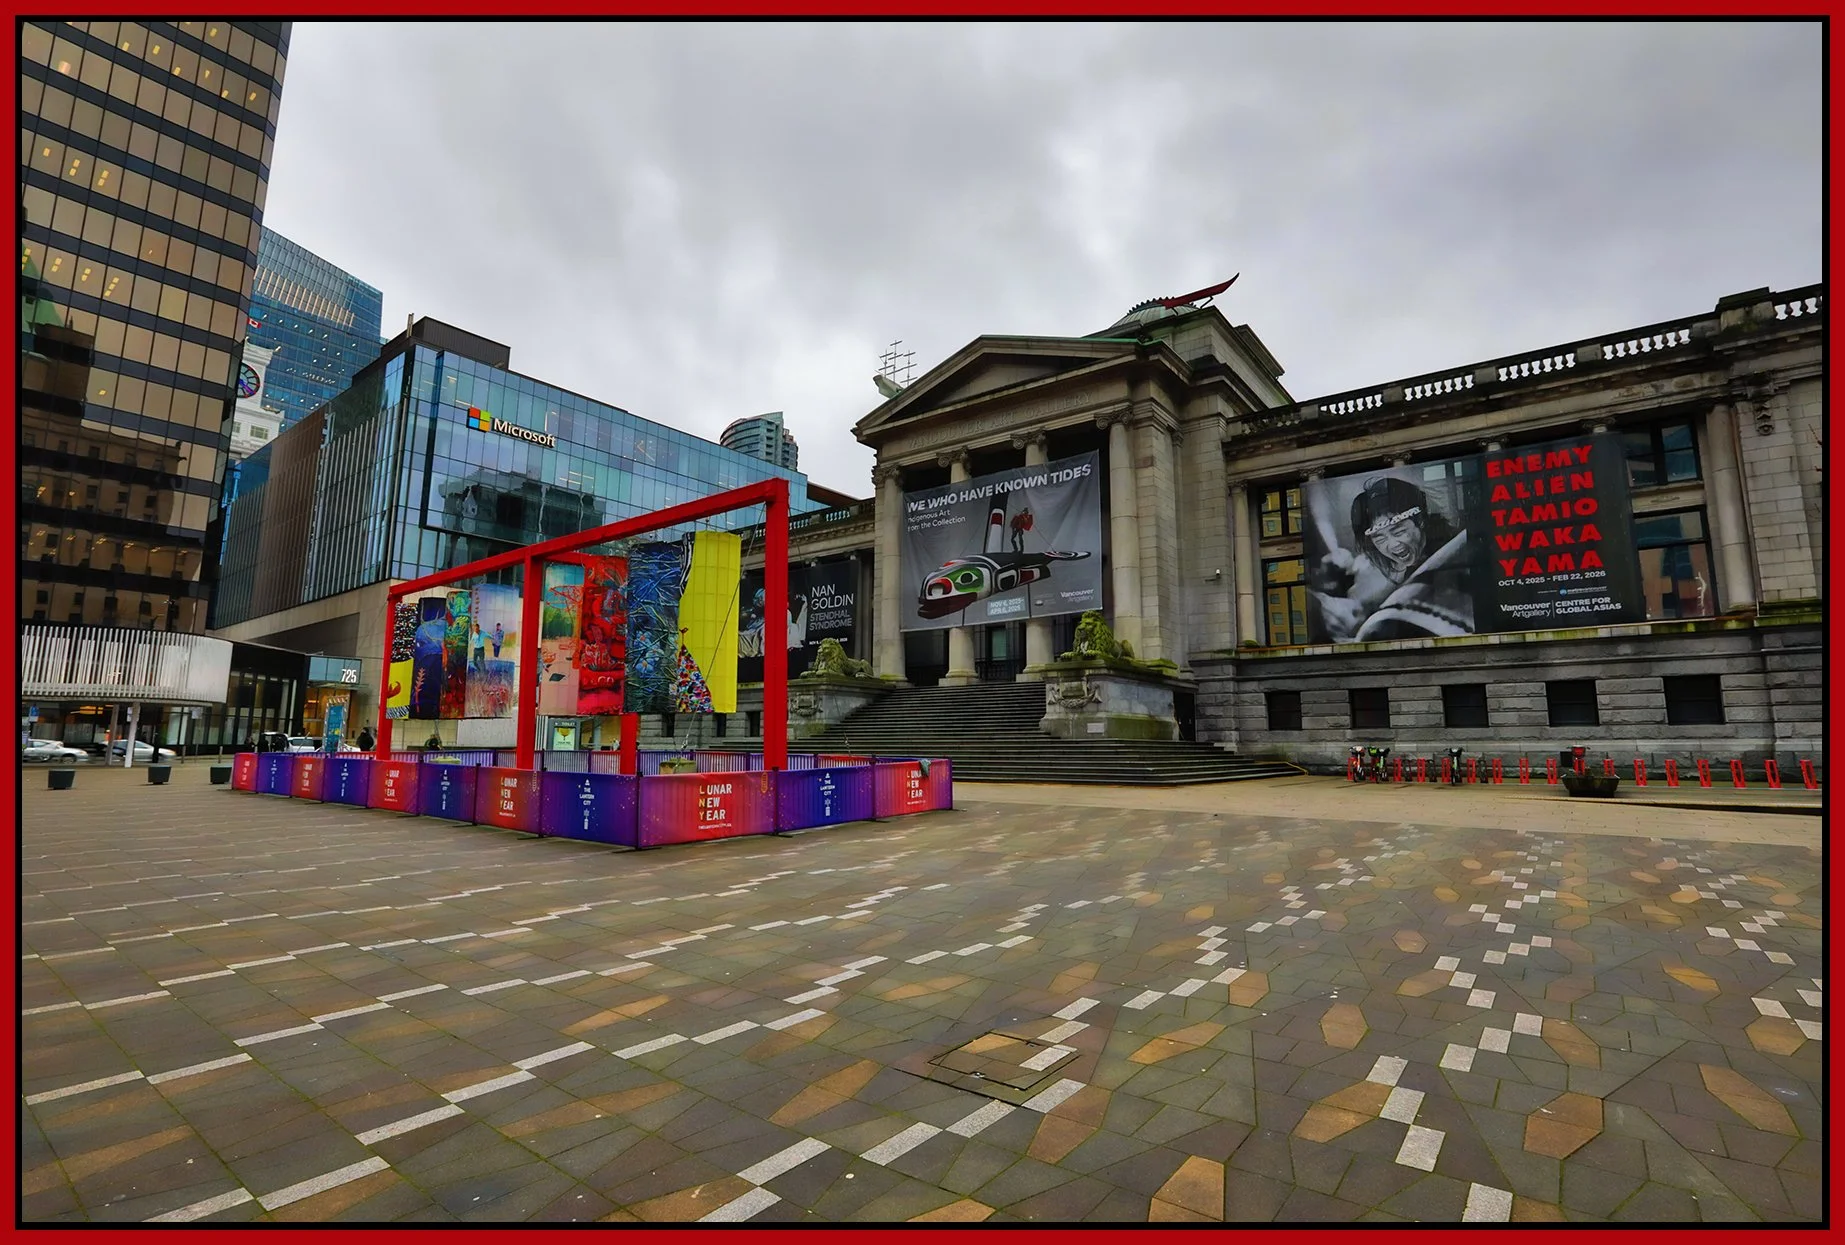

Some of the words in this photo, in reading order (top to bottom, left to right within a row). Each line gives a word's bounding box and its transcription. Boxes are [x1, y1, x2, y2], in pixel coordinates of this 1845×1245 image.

[908, 417, 984, 448] VANCOUVER
[991, 412, 1016, 428] ART
[1024, 392, 1092, 418] GALLERY
[494, 418, 556, 446] Microsoft
[1486, 444, 1593, 478] ENEMY
[907, 501, 926, 513] WE
[928, 494, 957, 510] WHO
[960, 485, 993, 502] HAVE
[995, 474, 1048, 494] KNOWN
[1050, 464, 1092, 483] TIDES
[1491, 471, 1594, 502] ALIEN
[908, 511, 938, 522] ndigenous
[1492, 498, 1598, 527] TAMIO
[932, 516, 965, 527] Collection
[1495, 523, 1602, 552] WAKA
[1499, 550, 1603, 577] YAMA
[1525, 576, 1545, 584] 2025
[811, 584, 836, 597] NAN
[1060, 589, 1094, 598] Vancouver
[811, 593, 854, 610] GOLDIN
[1500, 602, 1550, 612] Vancouver
[1512, 608, 1551, 618] Artgallery
[1556, 606, 1593, 614] GLOBAL
[1593, 603, 1621, 611] ASIAS
[810, 610, 850, 622] STENDHAL
[810, 618, 852, 631] SYNDROME
[341, 669, 357, 683] 725
[907, 770, 922, 779] LUNA
[500, 777, 518, 787] LUNAR
[907, 780, 919, 788] NEW
[699, 784, 732, 795] LUNAR
[907, 789, 923, 798] YEAR
[500, 800, 514, 810] YEAR
[699, 797, 720, 808] NEW
[699, 809, 726, 821] YEAR
